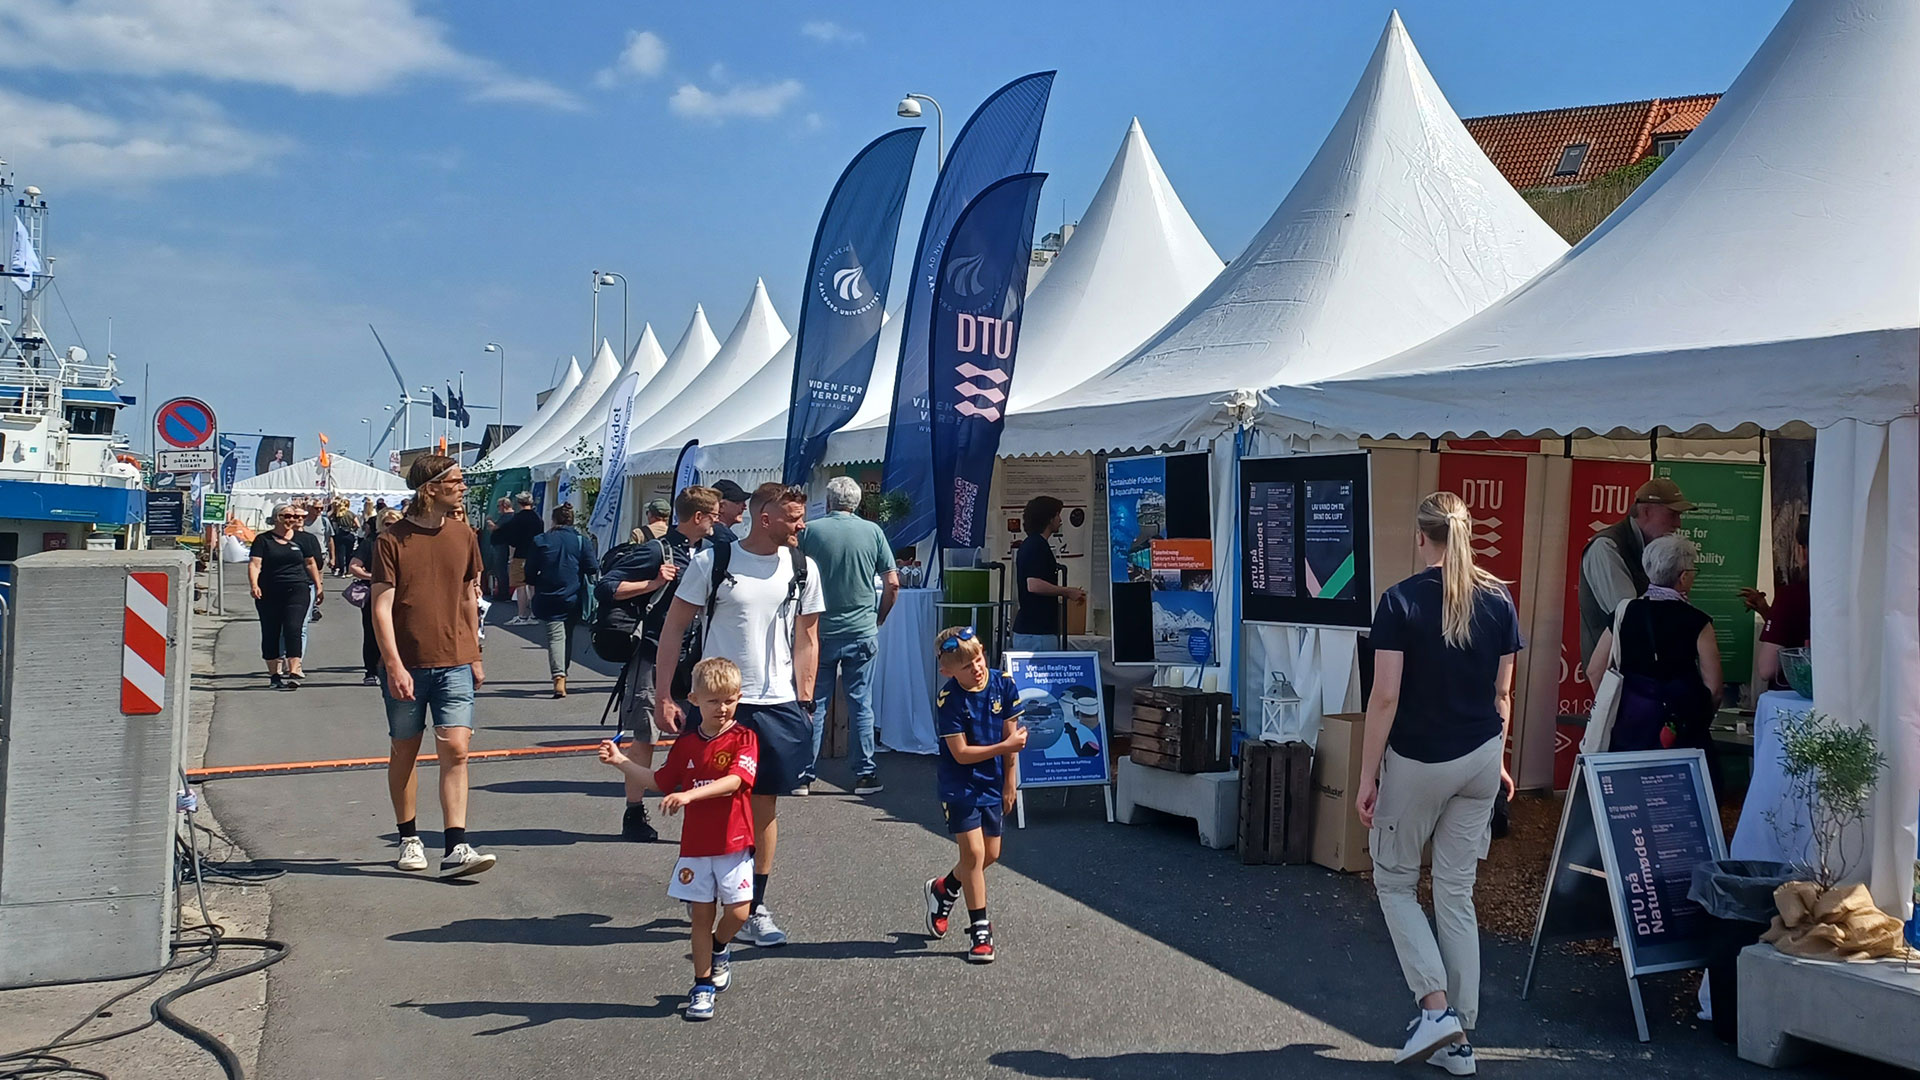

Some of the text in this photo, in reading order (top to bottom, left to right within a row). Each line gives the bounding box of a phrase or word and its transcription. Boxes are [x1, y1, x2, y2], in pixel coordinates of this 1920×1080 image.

[818, 282, 880, 316] AALBORG UNIVERSITET
[957, 313, 1014, 359] DTU
[808, 380, 862, 394] VIDEN FOR
[812, 390, 854, 402] VERDEN
[1110, 476, 1162, 486] Sustainable Fisheries
[1462, 479, 1503, 510] DTU
[1591, 484, 1630, 514] DTU
[1694, 527, 1708, 538] for
[1250, 549, 1258, 564] på
[1631, 828, 1665, 934] Naturmødet
[1625, 872, 1650, 936] DTU på
